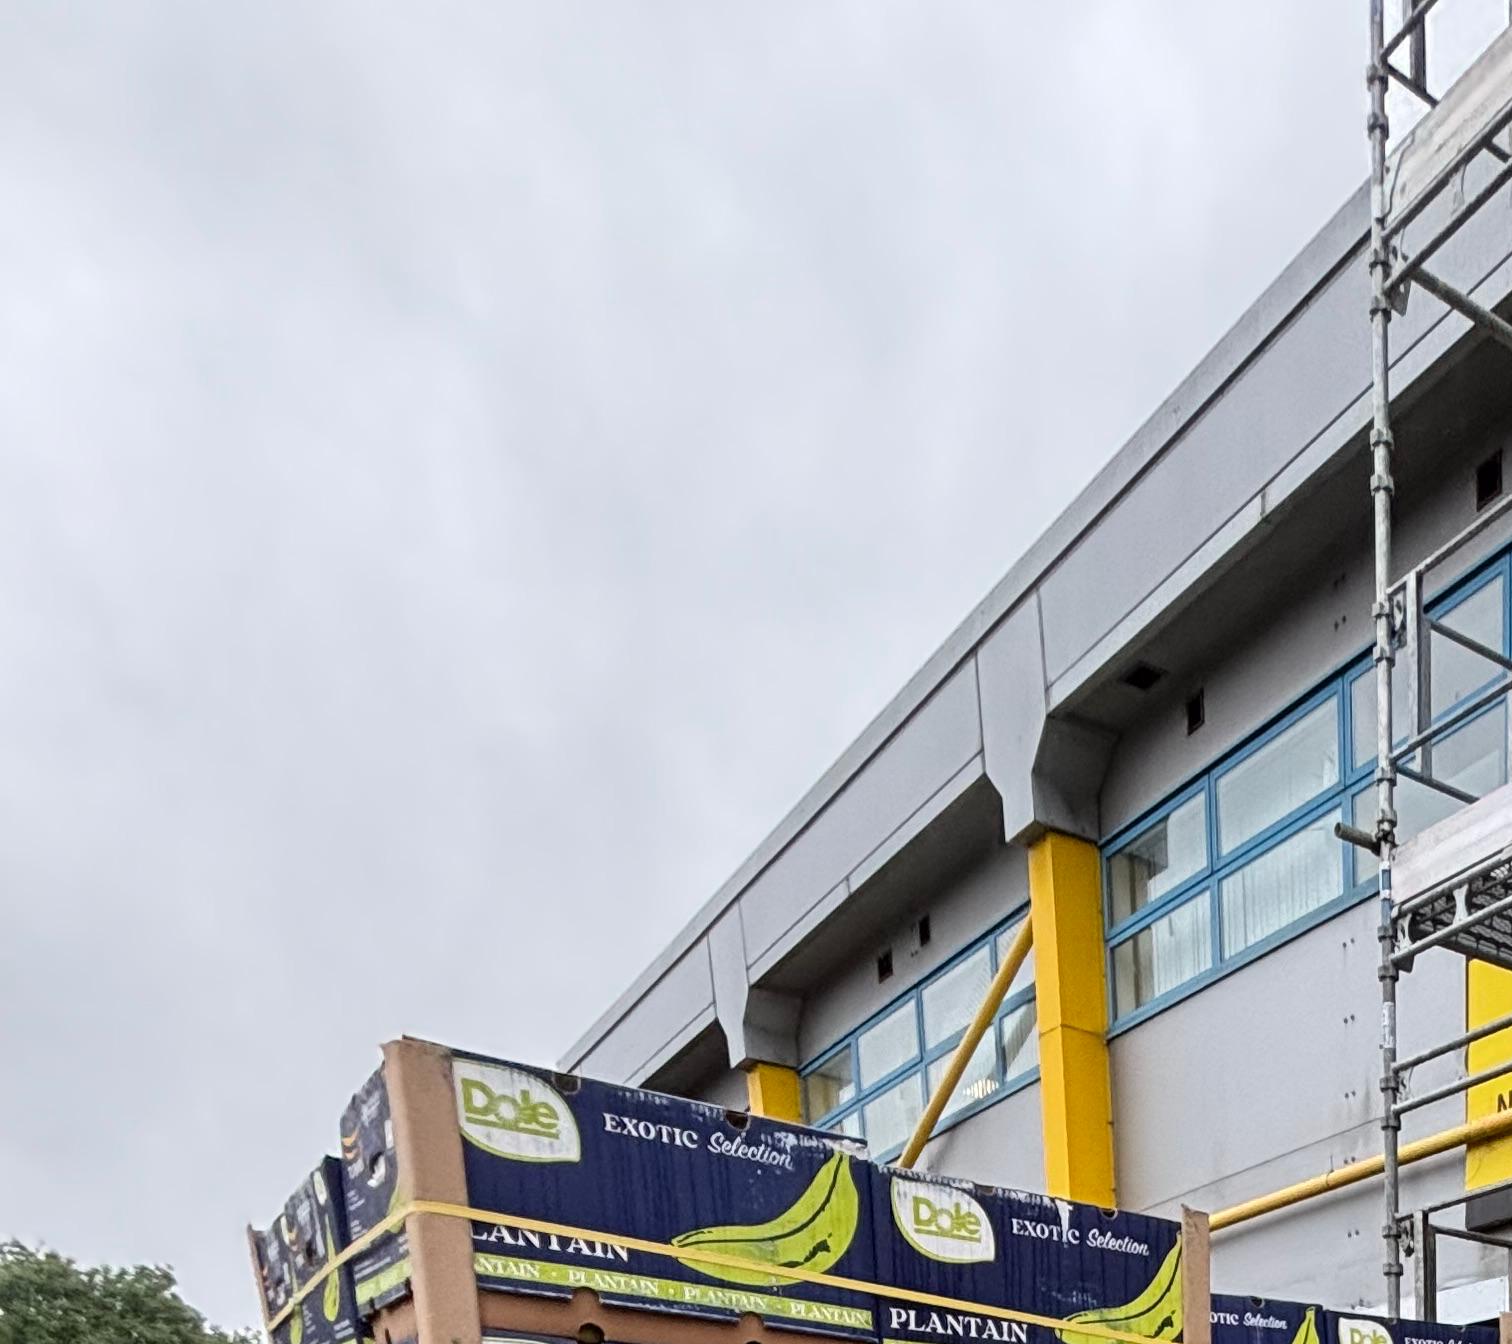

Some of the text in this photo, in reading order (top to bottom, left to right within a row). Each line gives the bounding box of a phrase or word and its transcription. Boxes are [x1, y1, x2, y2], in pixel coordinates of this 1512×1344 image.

[462, 1077, 560, 1136] Dole
[602, 1113, 793, 1167] EXOTIC Selection
[912, 1196, 981, 1239] Dole
[1087, 1232, 1148, 1256] Selection
[568, 1269, 659, 1296] PLANTAIN
[889, 1307, 1028, 1343] PLANTAIN
[1243, 1313, 1288, 1330] Selection
